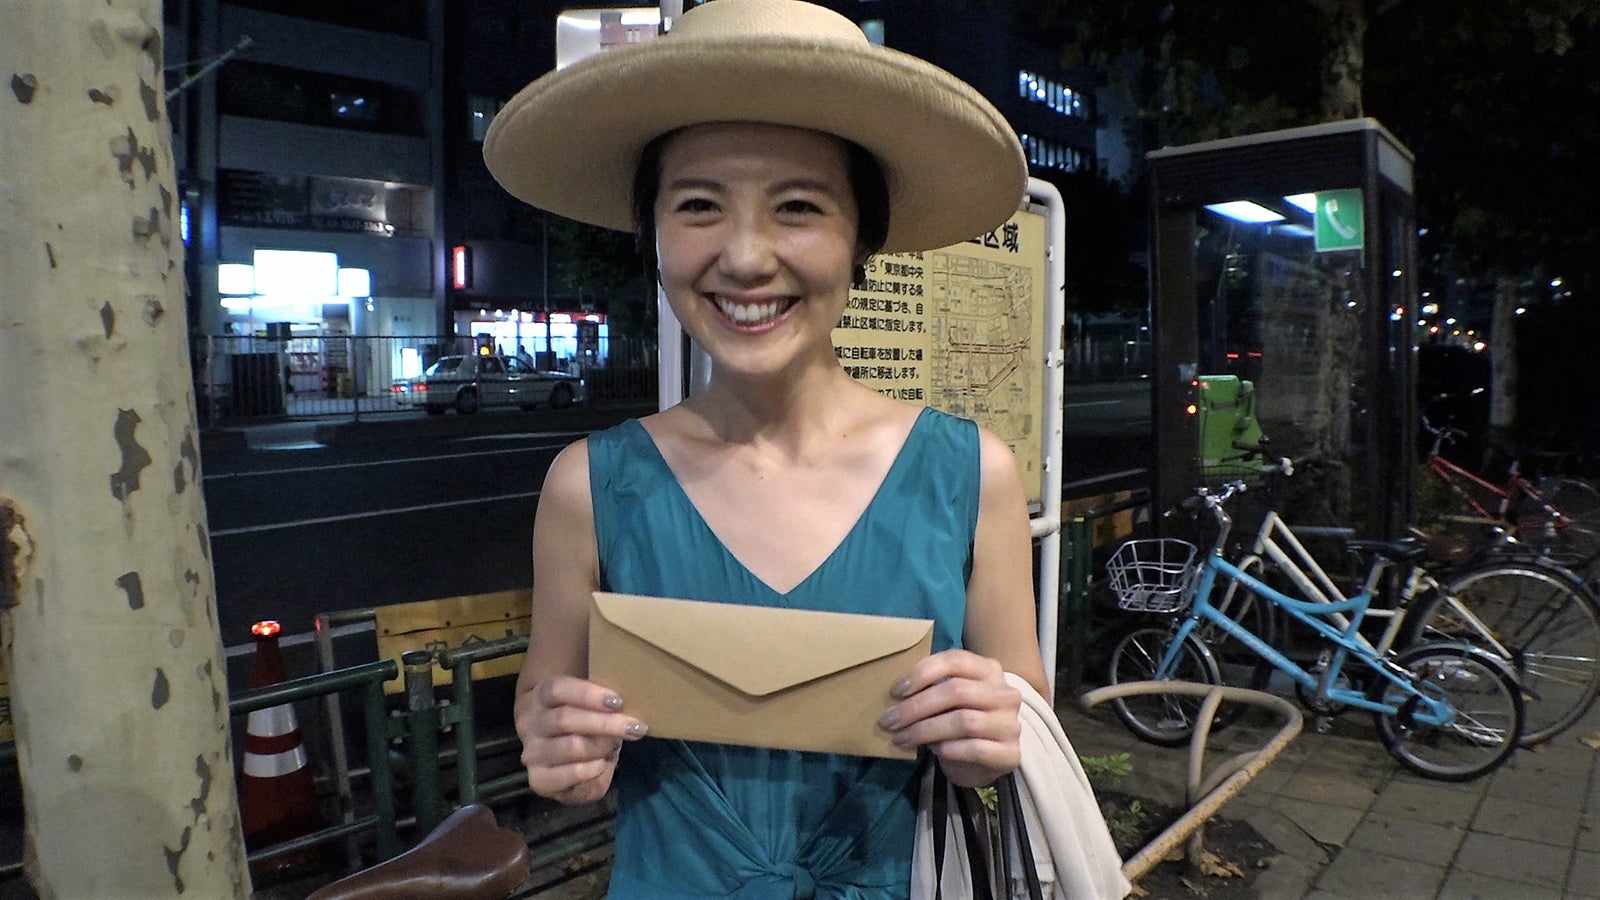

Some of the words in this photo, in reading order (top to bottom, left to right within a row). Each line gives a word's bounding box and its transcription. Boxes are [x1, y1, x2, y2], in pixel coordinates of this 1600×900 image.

[968, 222, 1018, 253] 区域
[846, 297, 923, 315] の規定に基づき、自
[836, 315, 927, 334] 禁止区域に指定します。
